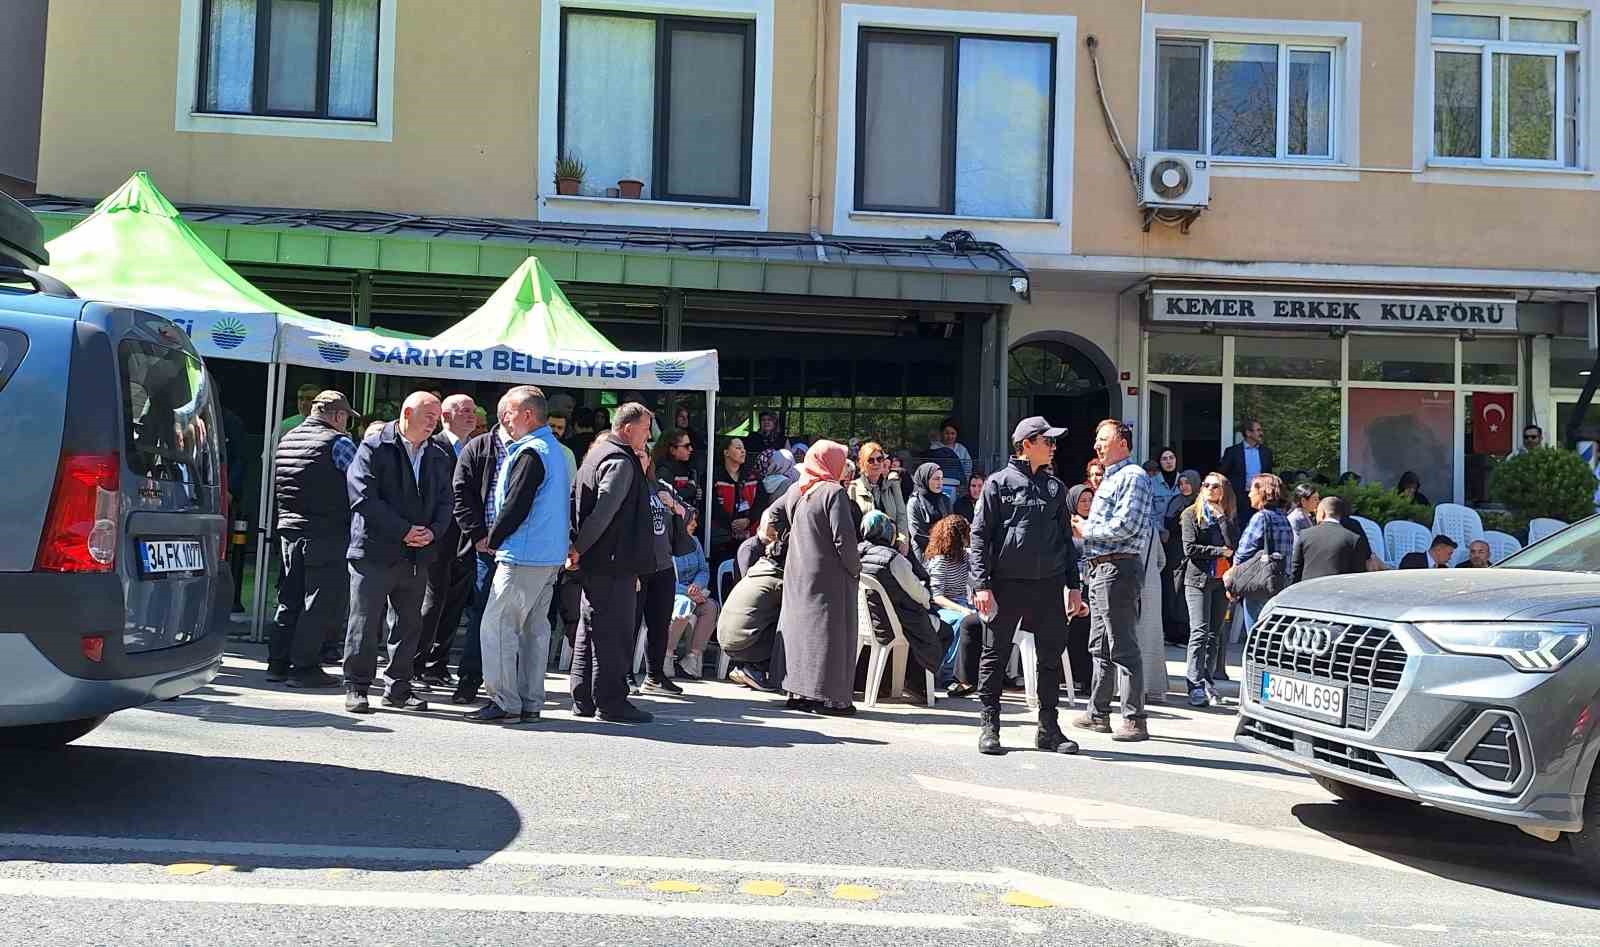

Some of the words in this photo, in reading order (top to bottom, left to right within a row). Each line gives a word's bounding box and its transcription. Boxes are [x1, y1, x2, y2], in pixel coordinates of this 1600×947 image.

[1166, 297, 1256, 317] KEMER
[1273, 300, 1361, 320] ERKEK
[1380, 302, 1504, 324] KUAFÖRÜ
[369, 344, 483, 369] SARIYER
[148, 543, 165, 570] 34
[165, 543, 183, 569] FK
